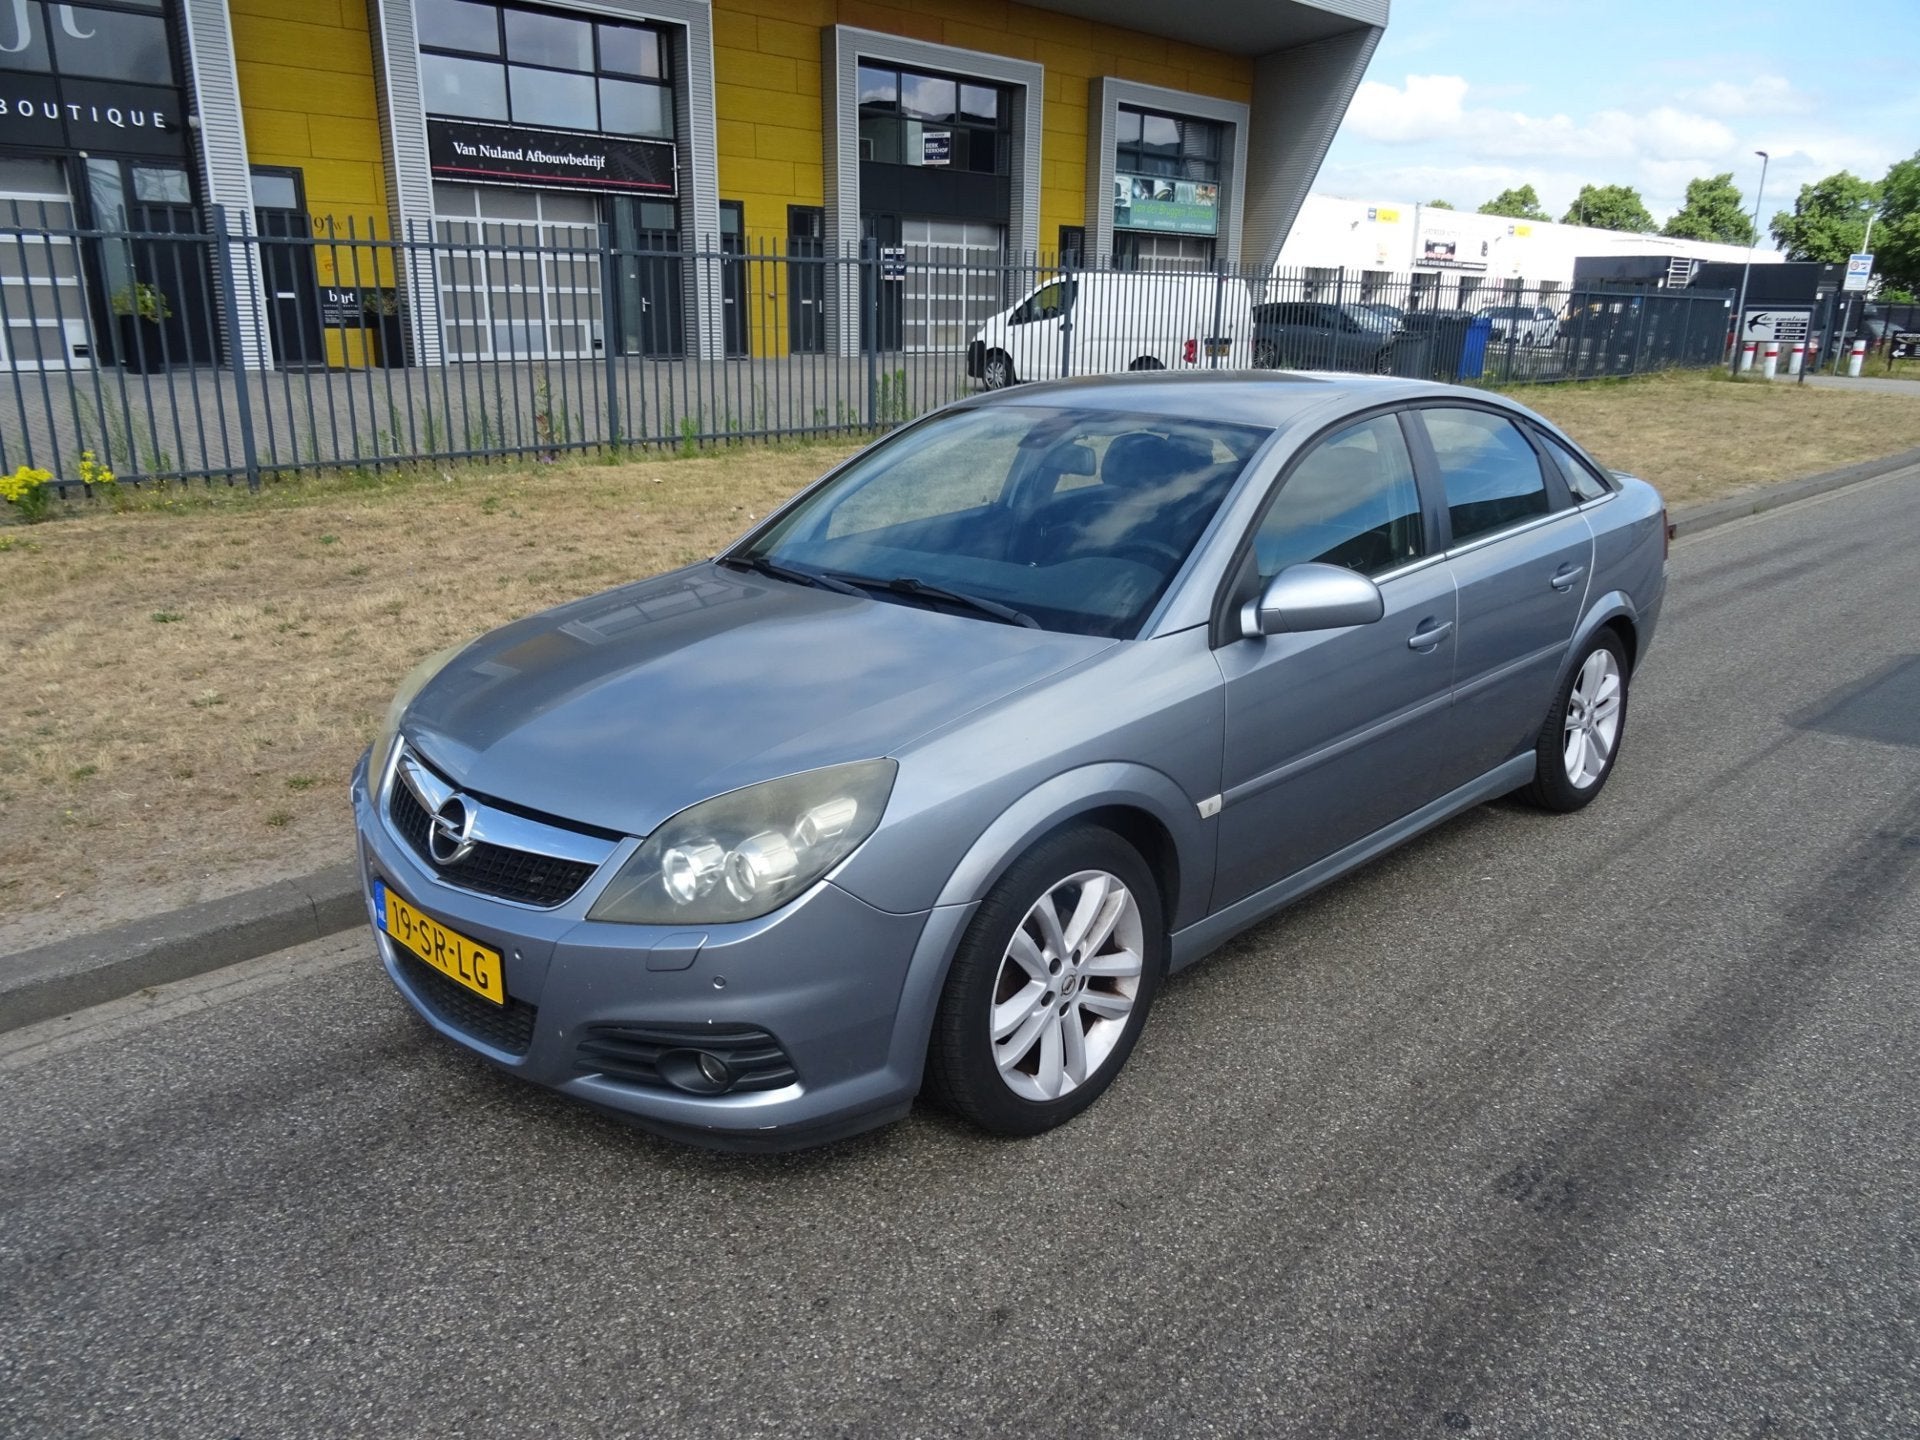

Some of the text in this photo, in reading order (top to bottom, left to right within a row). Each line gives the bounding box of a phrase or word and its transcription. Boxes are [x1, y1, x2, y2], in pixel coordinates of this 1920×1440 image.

[452, 141, 606, 171] Van Nuland Afbouwbedrijf
[393, 900, 489, 990] 19-SR-LG
